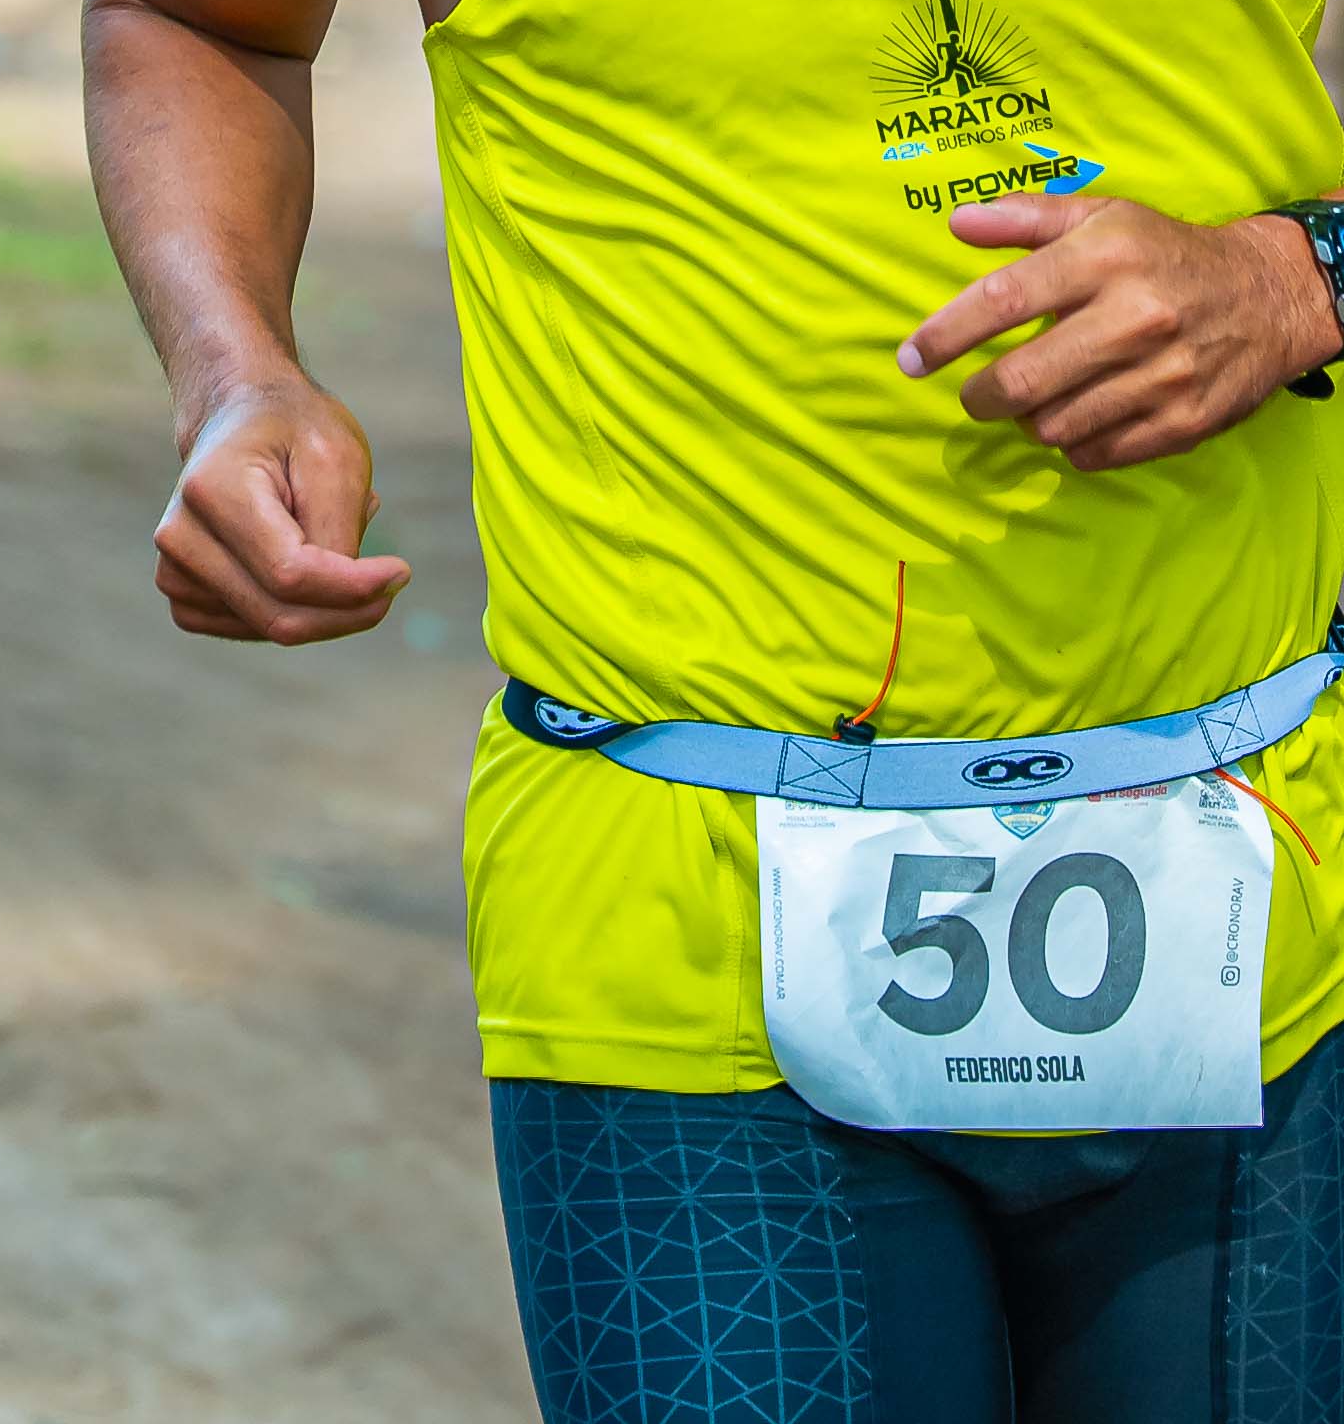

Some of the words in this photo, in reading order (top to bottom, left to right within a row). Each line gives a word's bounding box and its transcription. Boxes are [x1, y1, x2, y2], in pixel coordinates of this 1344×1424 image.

[875, 88, 1051, 144] MARATON
[882, 141, 933, 161] 42K
[936, 126, 1006, 152] BUENOS
[1010, 116, 1054, 139] AIRES
[903, 183, 943, 214] by
[947, 155, 1080, 204] POWER
[876, 851, 1147, 1037] 50
[1225, 877, 1244, 963] @CRONORAV
[944, 1056, 1034, 1083] FEDERICO
[1036, 1055, 1086, 1082] SOLA
